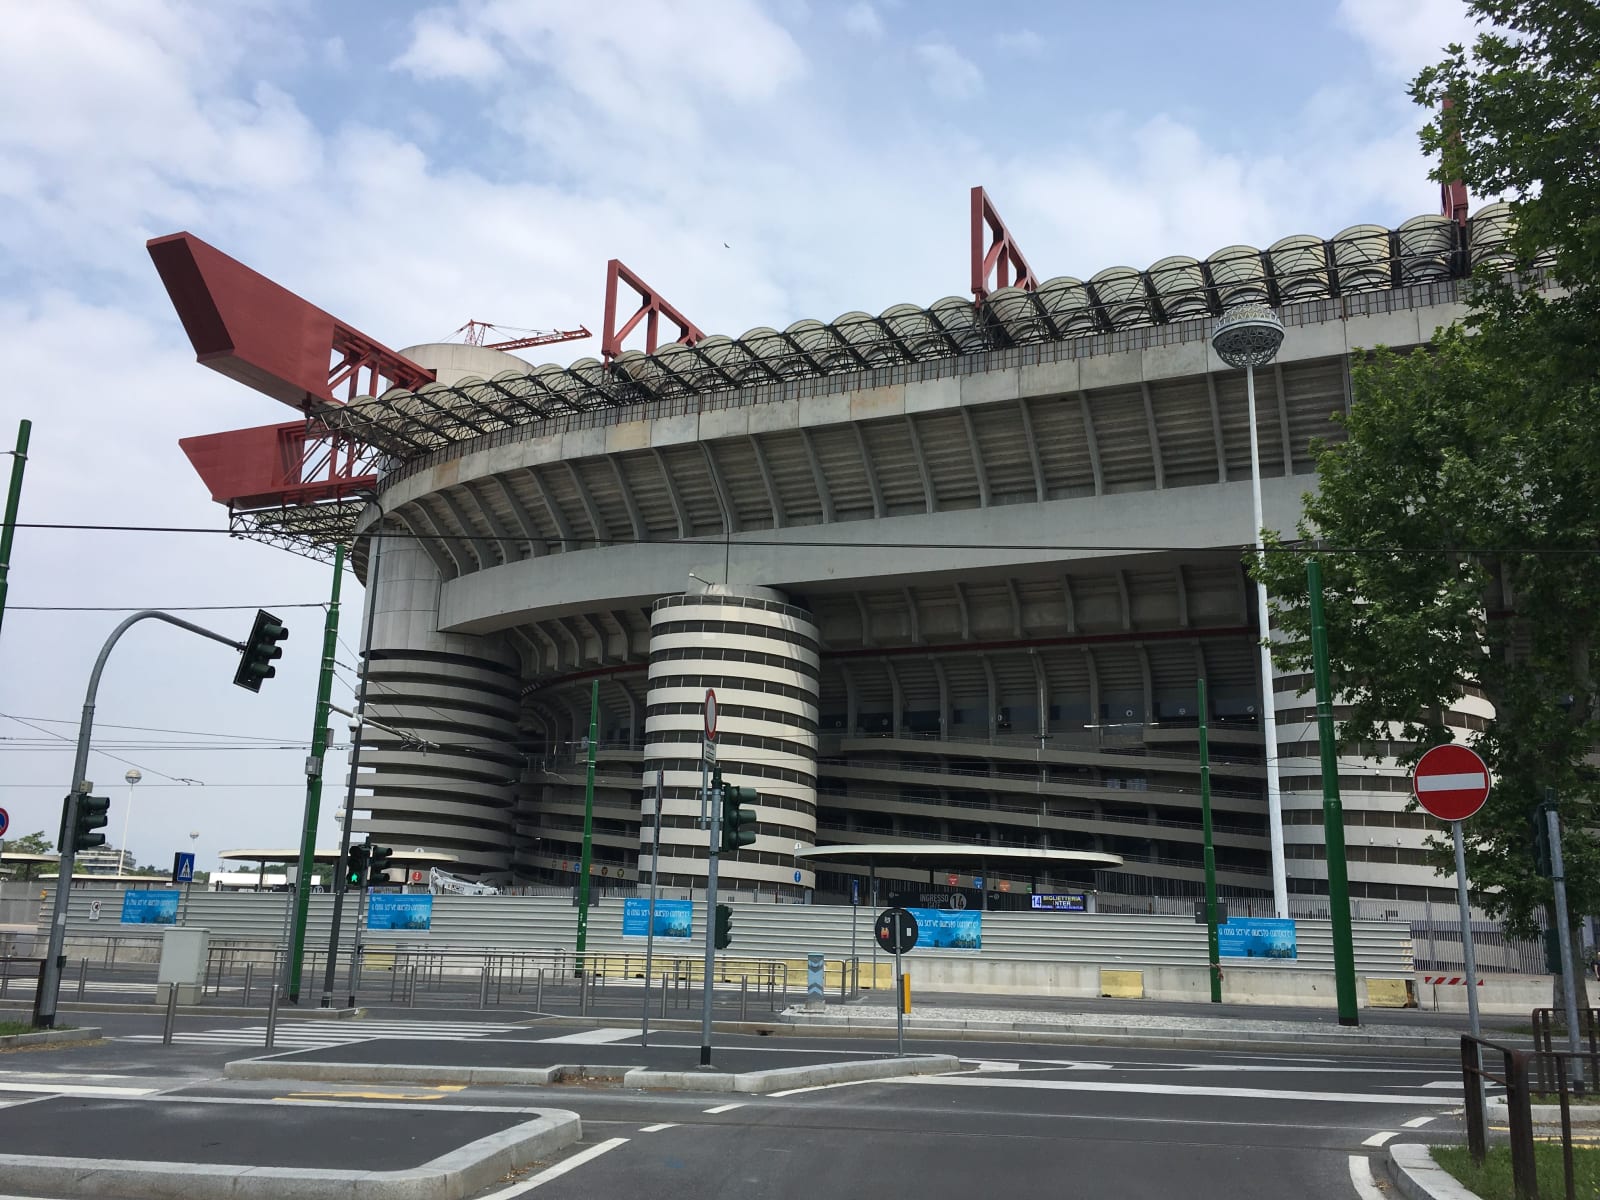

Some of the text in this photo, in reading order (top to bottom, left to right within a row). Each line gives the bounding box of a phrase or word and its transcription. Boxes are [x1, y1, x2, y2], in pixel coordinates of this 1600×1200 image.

[920, 894, 965, 909] INGRESSO 14
[1032, 896, 1041, 907] 14
